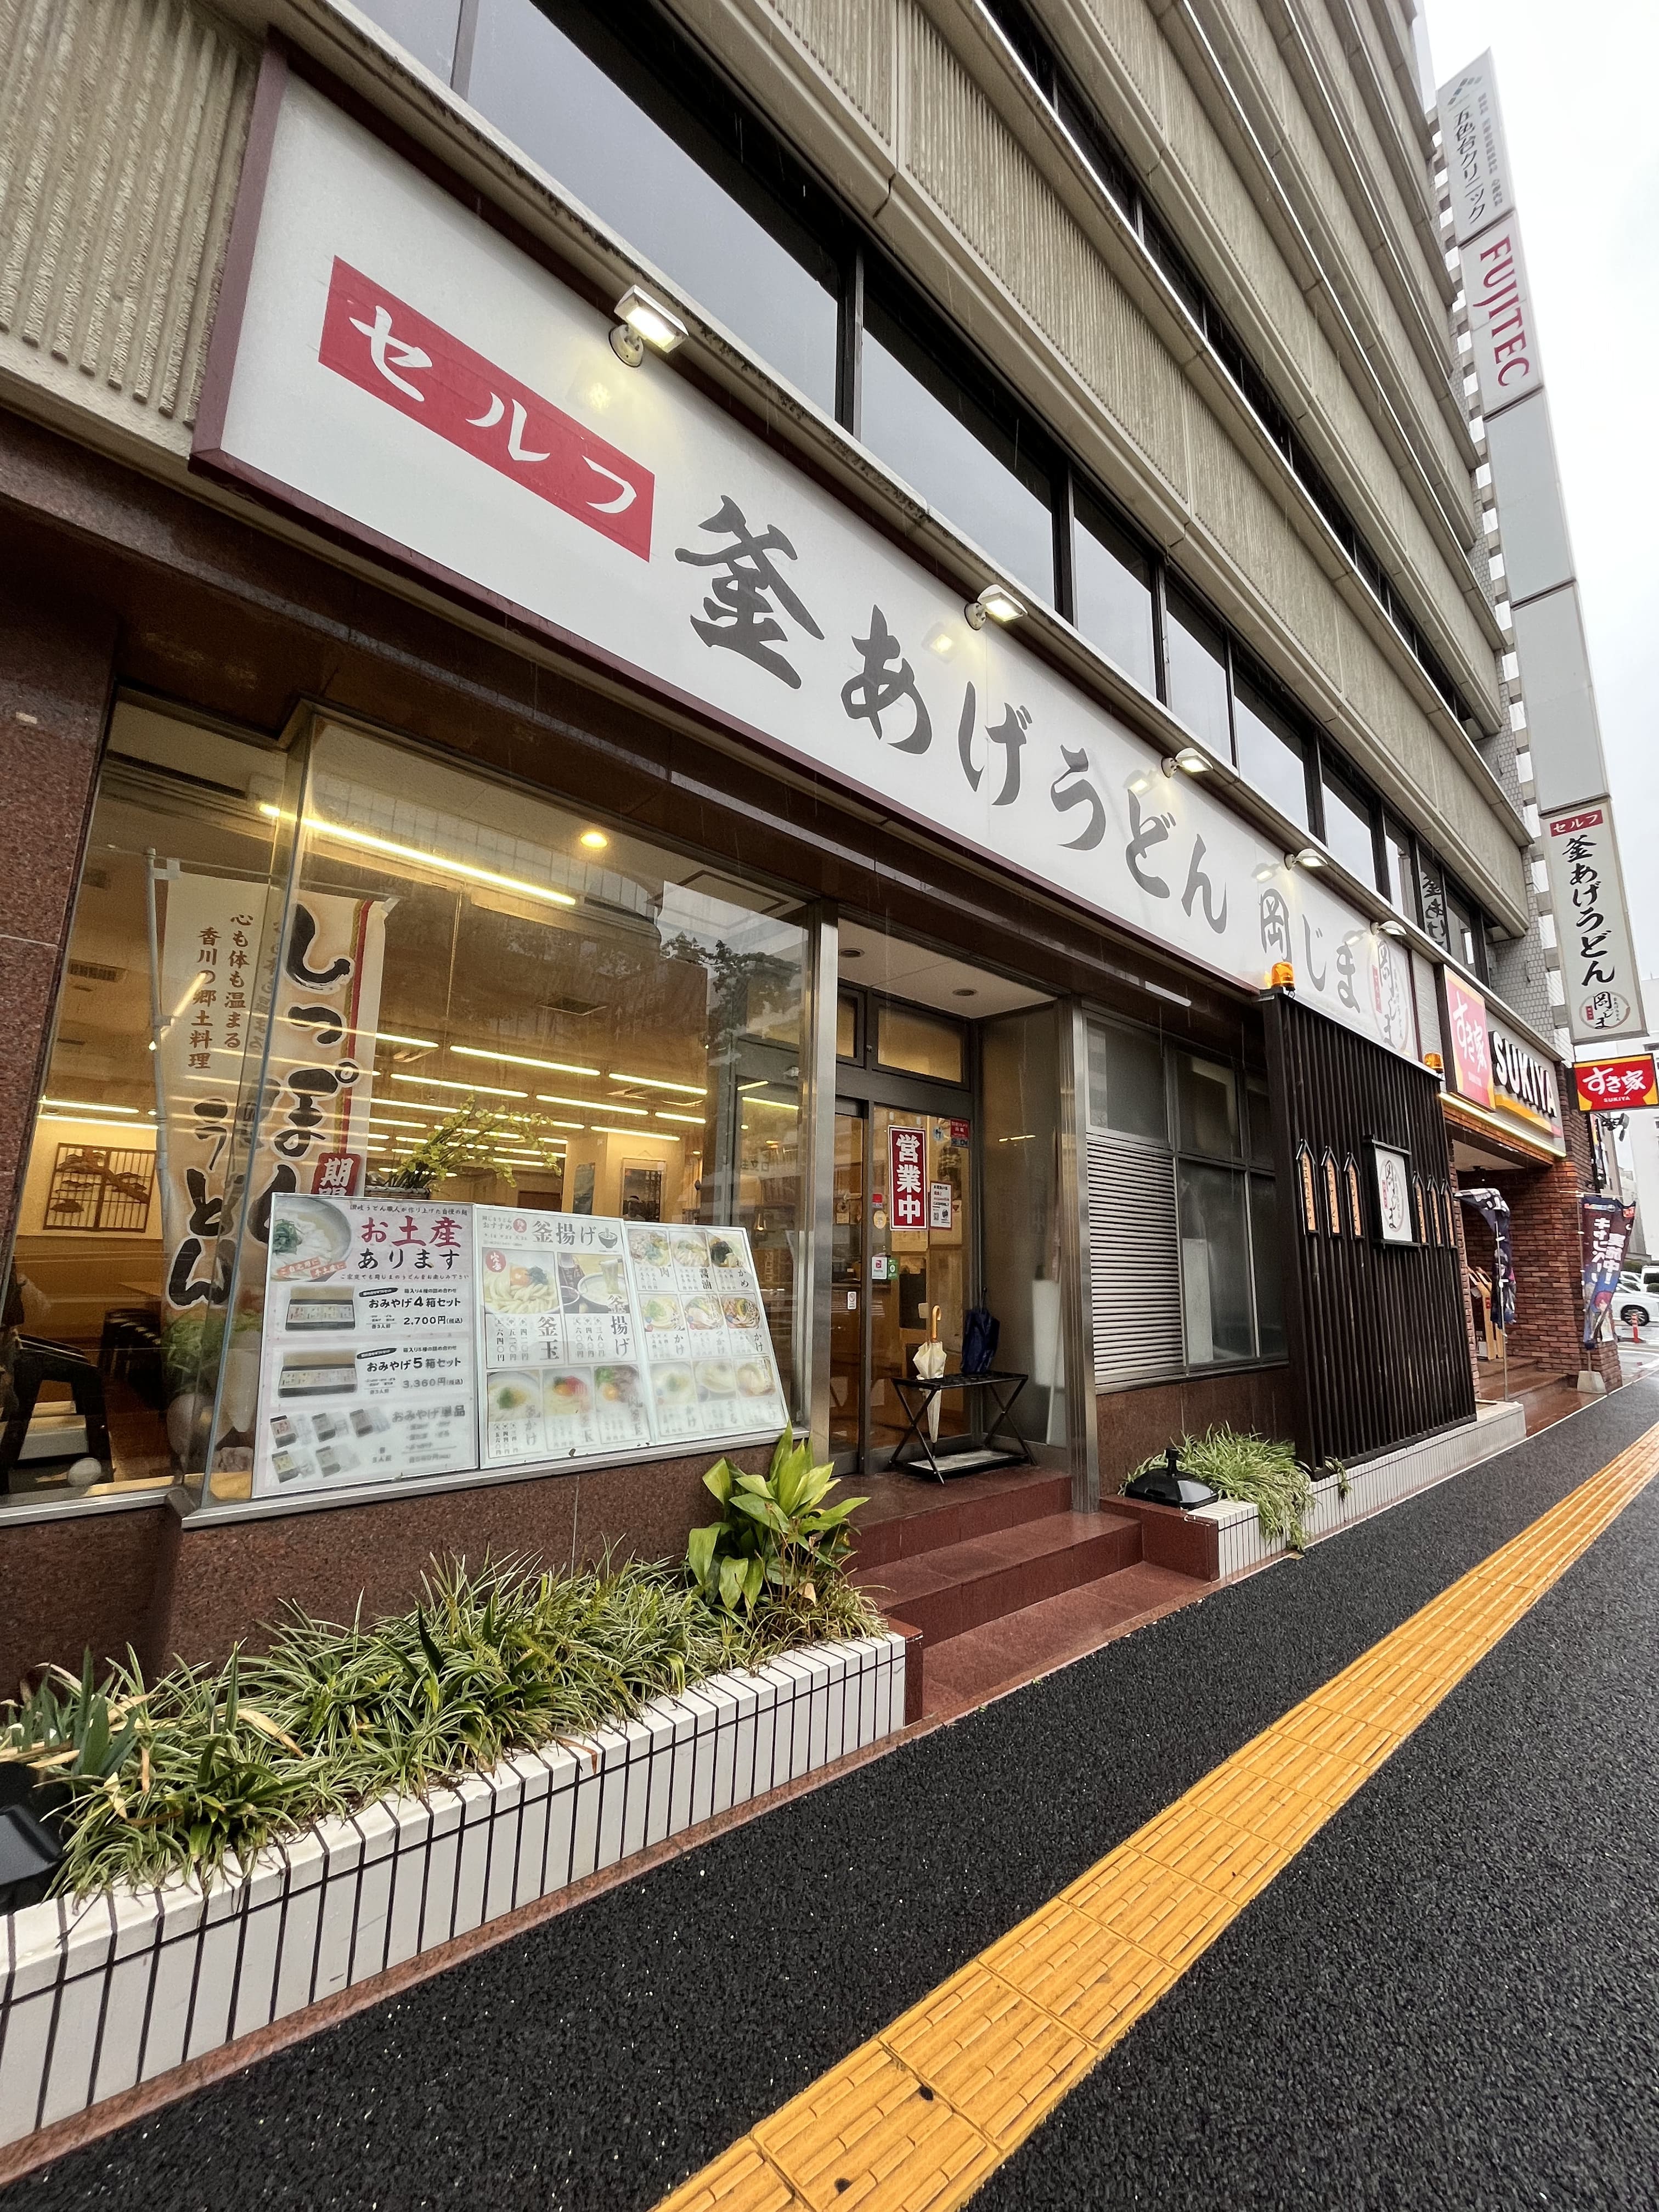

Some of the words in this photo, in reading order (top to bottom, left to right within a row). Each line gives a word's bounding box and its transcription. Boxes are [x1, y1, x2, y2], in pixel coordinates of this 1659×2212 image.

[1472, 234, 1530, 386] FUJITEC
[349, 305, 636, 514] セルフ
[675, 495, 1227, 934] 釜あげうどん
[1260, 888, 1361, 1013] 岡じま
[1553, 814, 1599, 833] セルフ
[1562, 834, 1615, 986] 釜あげうどん
[188, 927, 221, 1069] 香川の郷土料理
[224, 914, 253, 1048] 心も体も温まる
[1453, 991, 1487, 1073] すき家
[1594, 991, 1613, 1029] 岡じま
[1493, 1031, 1558, 1118] SUKIYA
[1582, 1066, 1646, 1096] すき家
[895, 1133, 922, 1224] 営業中
[361, 1215, 462, 1248] お土産
[533, 1220, 596, 1246] 釜揚げ
[358, 1248, 460, 1270] あります
[699, 1267, 713, 1290] 醤油
[368, 1296, 461, 1308] おみやげ4箱セット
[607, 1295, 630, 1357] 釜揚げ
[366, 1357, 461, 1372] おみやげ5箱セット
[537, 1316, 560, 1361] 釜玉
